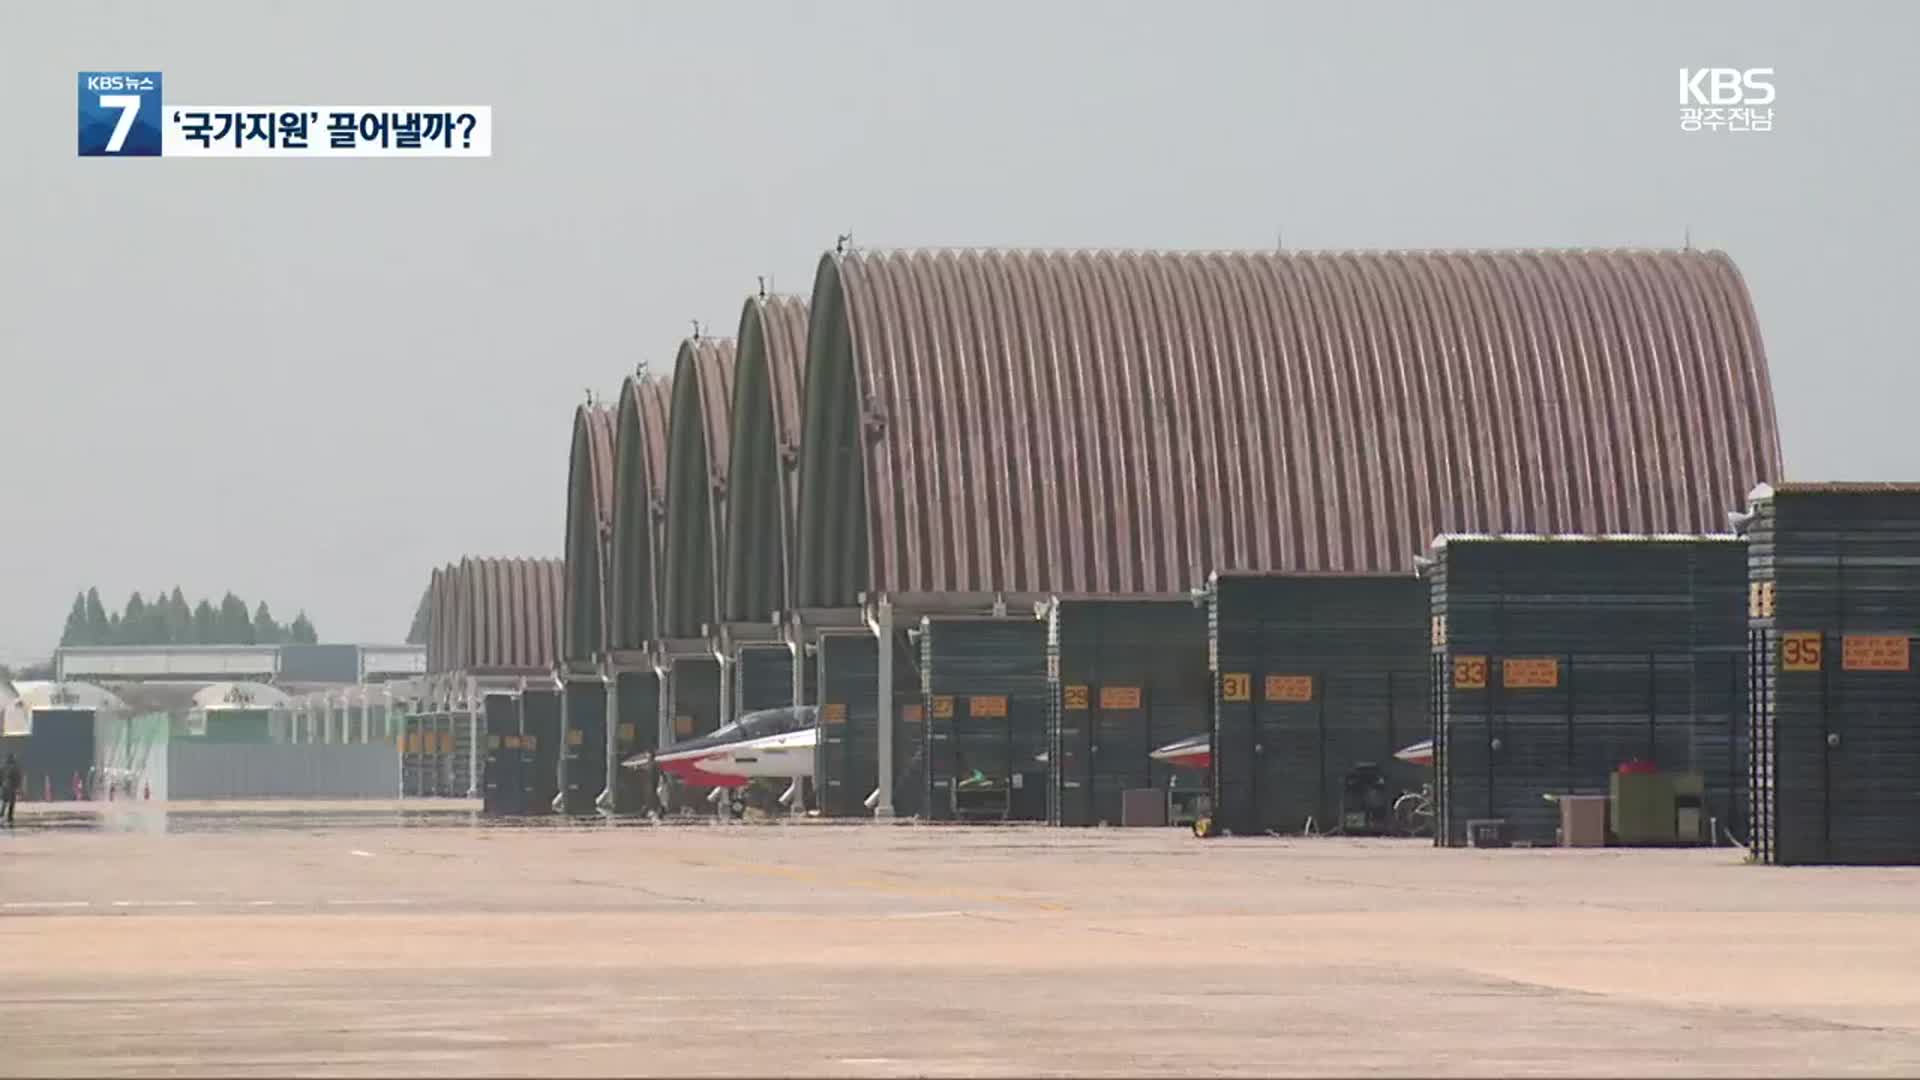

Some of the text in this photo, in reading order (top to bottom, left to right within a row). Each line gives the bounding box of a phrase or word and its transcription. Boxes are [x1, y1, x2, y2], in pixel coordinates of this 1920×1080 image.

[1784, 638, 1819, 665] 35
[1455, 662, 1485, 683] 33
[1224, 678, 1246, 697] 31
